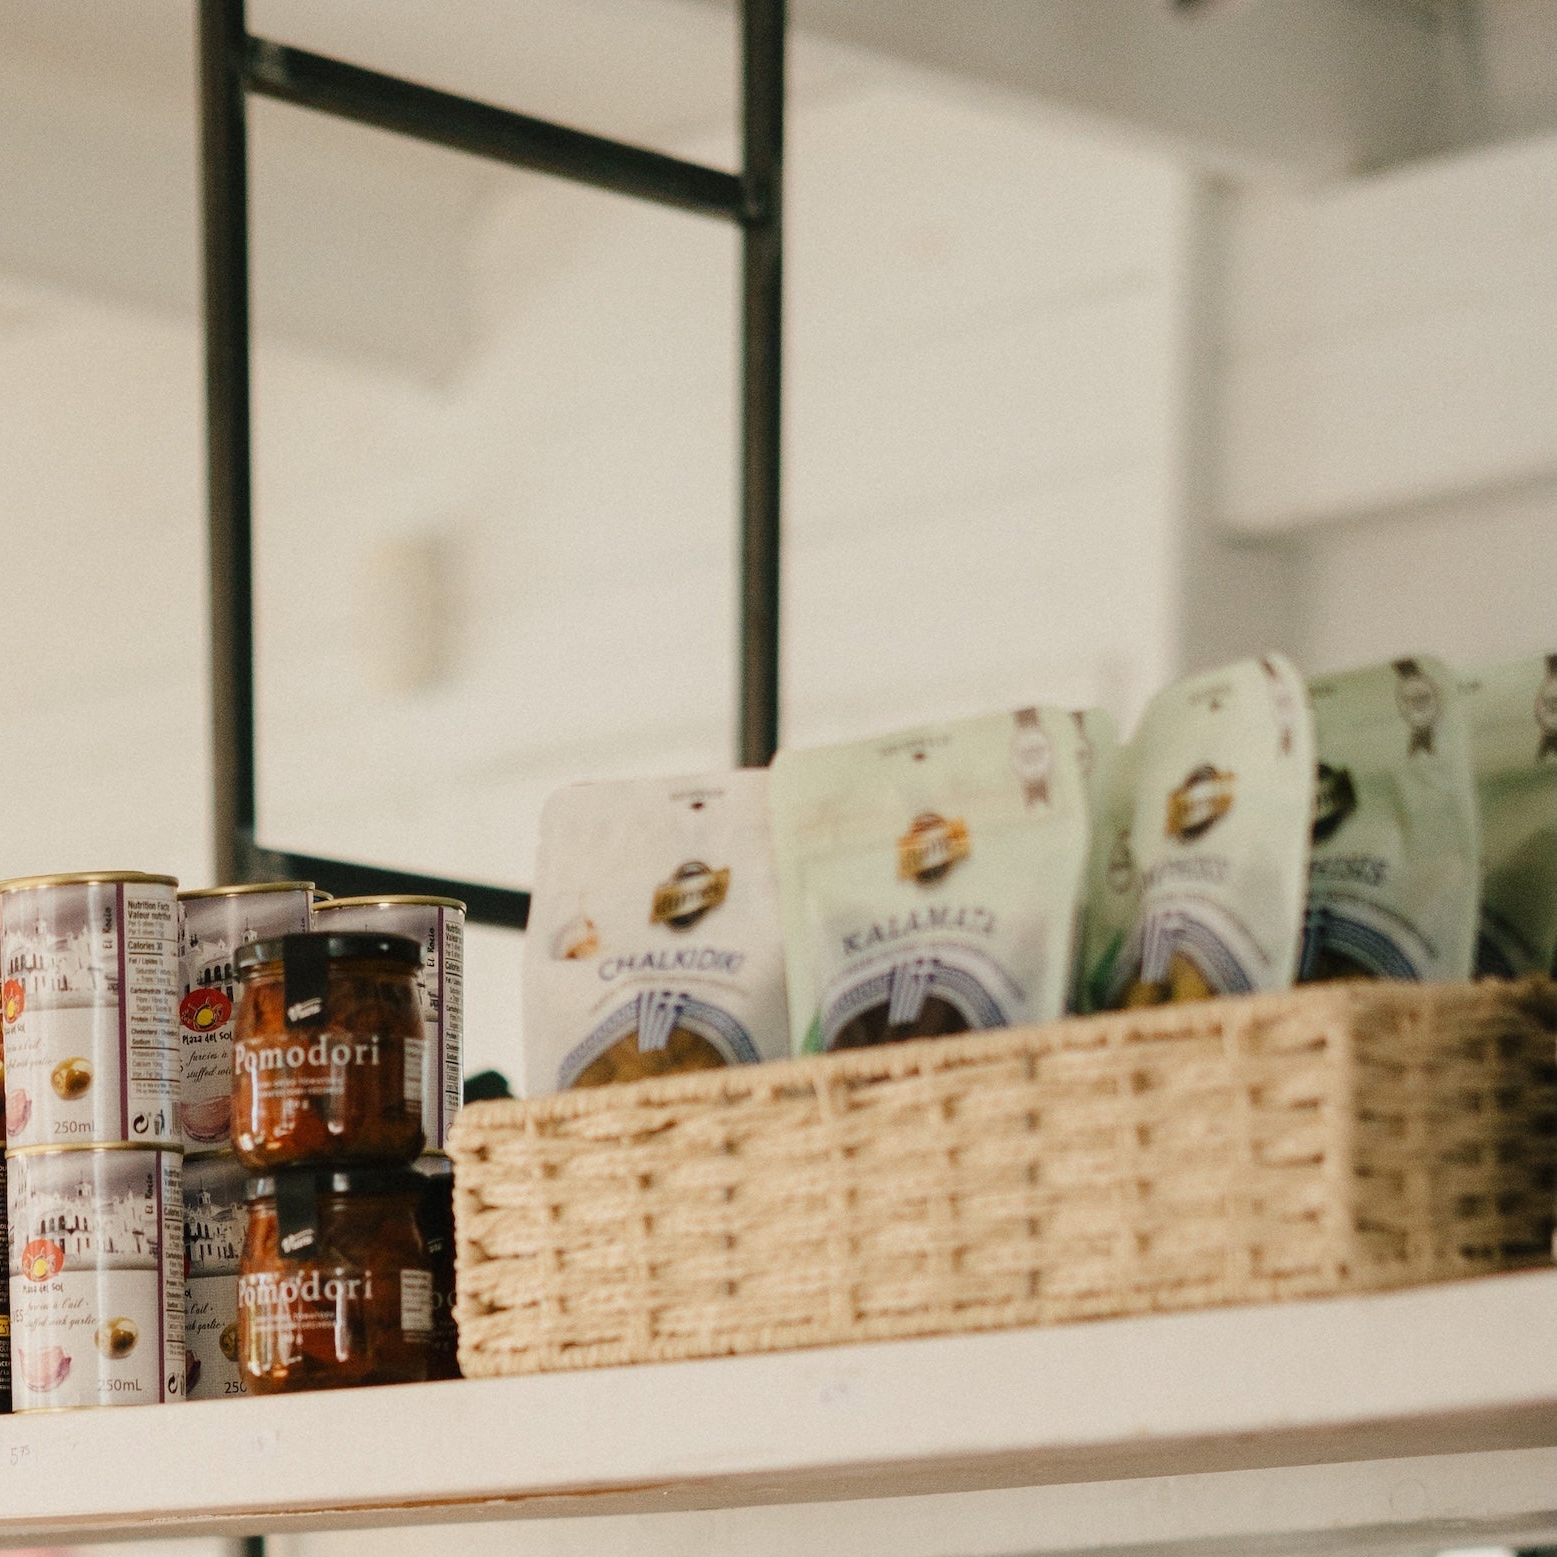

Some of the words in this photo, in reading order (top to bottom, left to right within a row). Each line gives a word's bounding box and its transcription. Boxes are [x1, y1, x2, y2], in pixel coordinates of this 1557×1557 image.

[235, 1033, 380, 1075] Pomodori
[238, 1267, 373, 1308] Pomodori
[98, 1378, 143, 1392] 250mL
